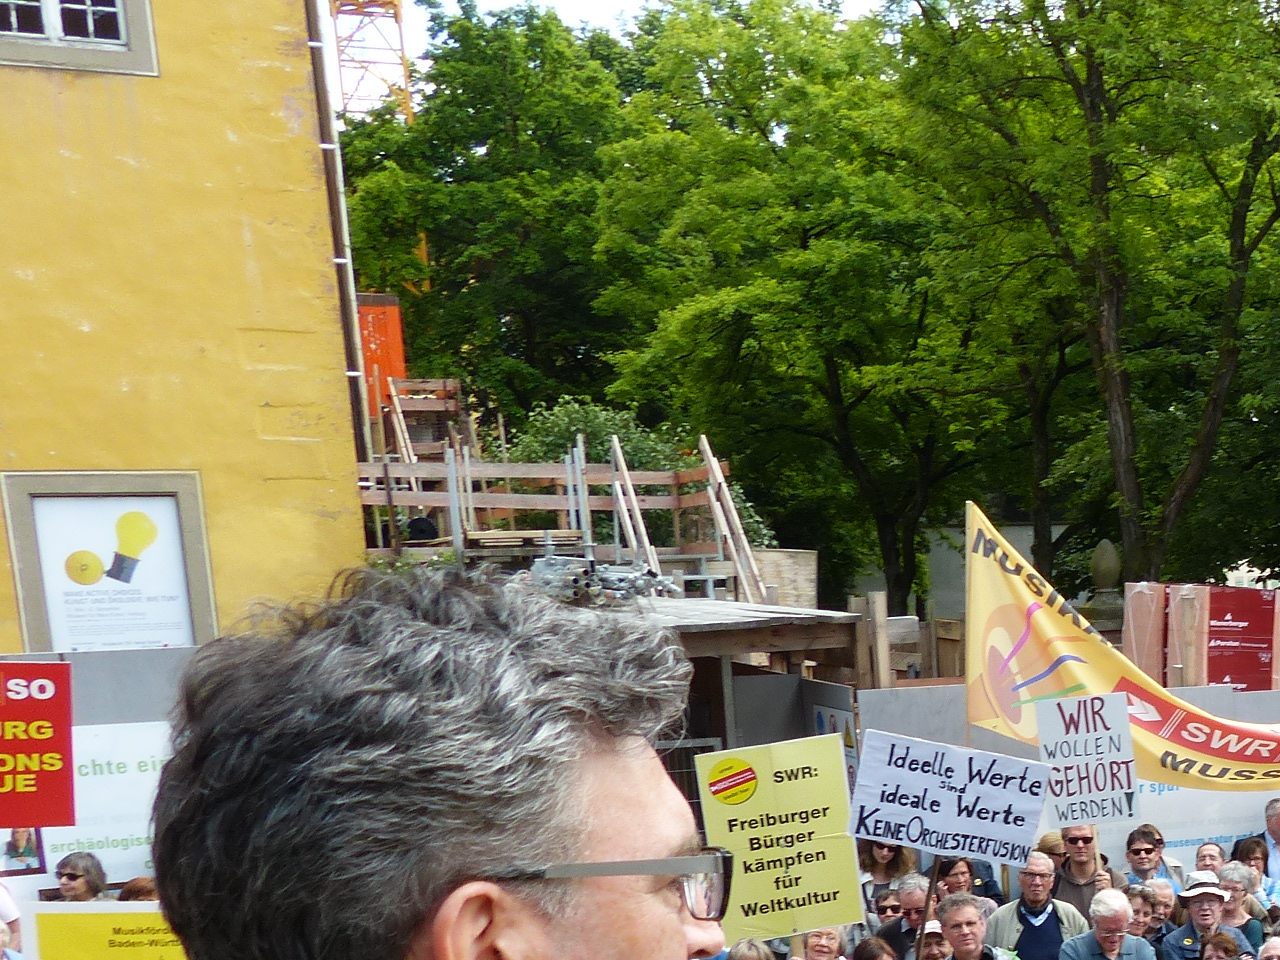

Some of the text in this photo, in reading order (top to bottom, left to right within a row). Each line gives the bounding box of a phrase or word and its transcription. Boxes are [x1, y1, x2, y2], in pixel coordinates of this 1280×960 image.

[6, 678, 56, 701] SO
[1056, 696, 1111, 736] WIR
[1043, 733, 1122, 760] WOLLEN
[1179, 722, 1278, 758] SWR
[773, 765, 819, 784] SWR:
[887, 743, 1042, 797] Ideelle Werte
[1048, 757, 1135, 798] GEHÖRT
[938, 780, 968, 795] sind
[880, 783, 1026, 828] ideale Werte
[1054, 791, 1135, 822] WERDEN!
[727, 806, 830, 833] Freiburger
[749, 828, 815, 851] Bürger
[743, 849, 827, 875] kämpfen
[774, 874, 802, 892] für
[740, 888, 840, 918] Weltkultur
[108, 937, 182, 949] Baden-Württ
[112, 926, 173, 937] Musikförd
